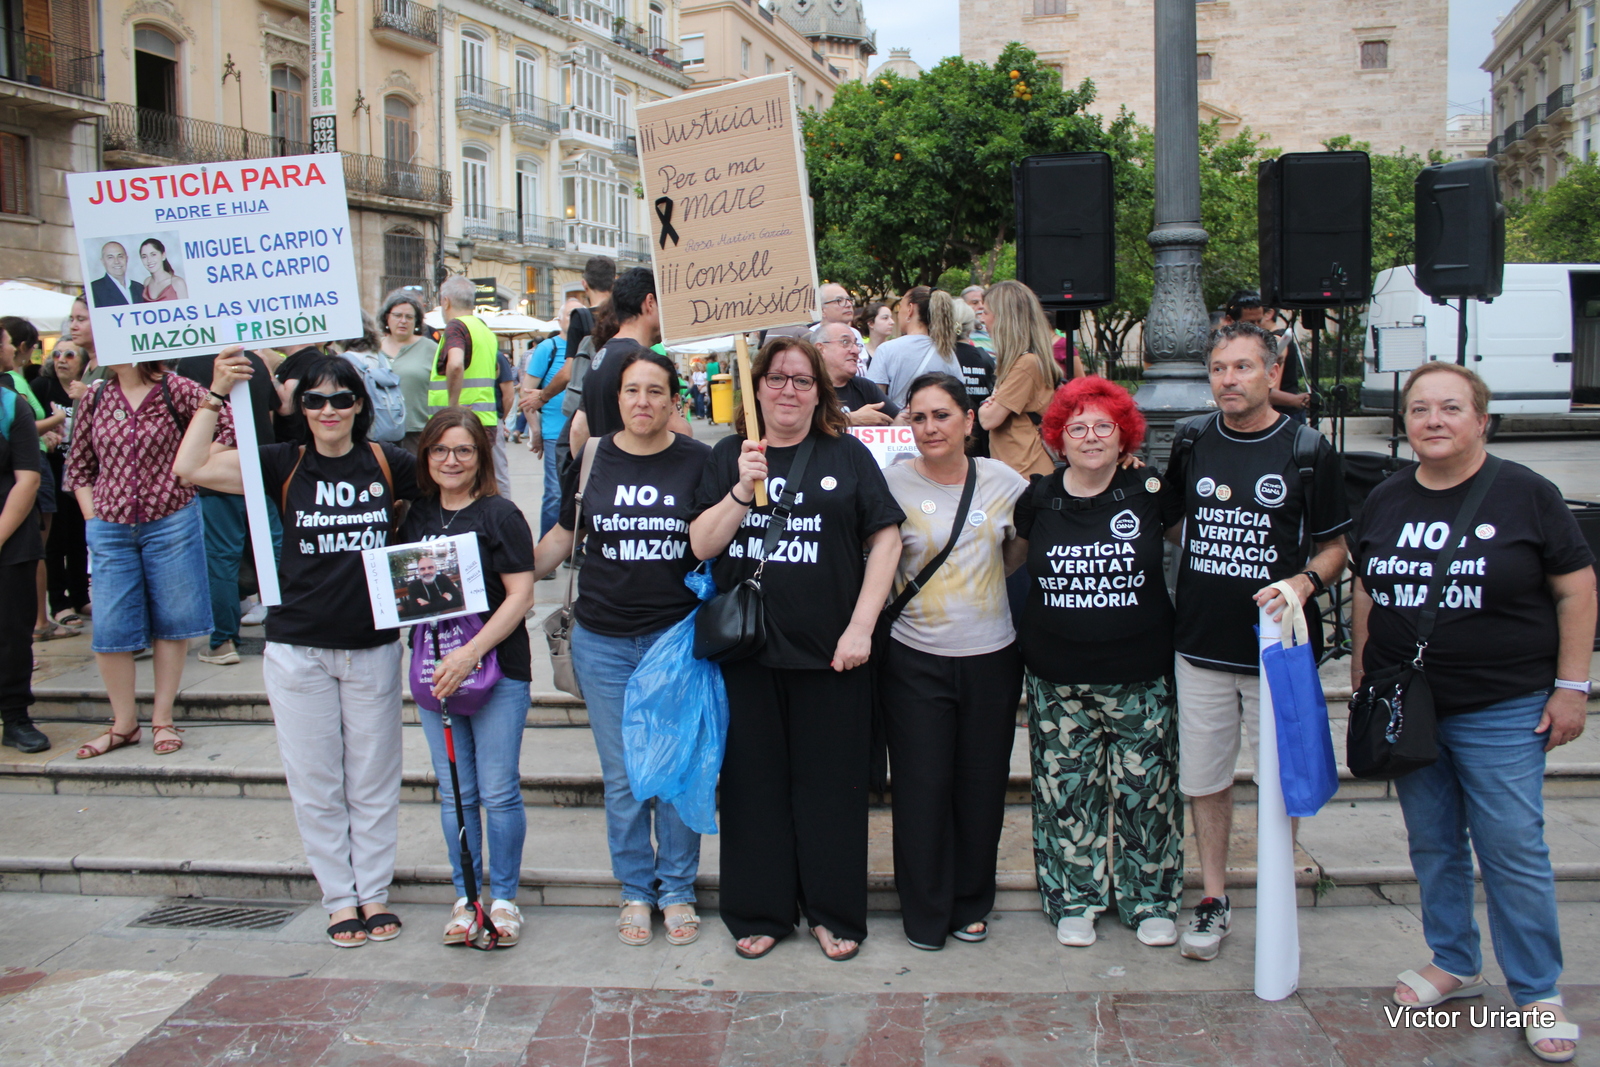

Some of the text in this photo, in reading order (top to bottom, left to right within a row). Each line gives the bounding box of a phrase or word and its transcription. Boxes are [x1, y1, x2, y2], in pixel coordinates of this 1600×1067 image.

[312, 116, 334, 130] 960
[313, 129, 334, 142] 032
[313, 141, 335, 154] 346
[241, 162, 326, 191] PARA
[658, 156, 765, 194] Per a ma
[155, 199, 269, 222] PADRE E HIJA
[680, 184, 765, 222] mare
[184, 227, 344, 260] MIGUEL CARPIO Y
[684, 239, 715, 253] Rosa
[206, 255, 330, 284] SARA CARPIO
[112, 291, 339, 328] Y TODAS LAS VICTIMAS
[130, 312, 328, 352] MAZÓN PRISIÓN
[315, 480, 370, 508] NO a
[613, 484, 675, 506] NO a
[764, 477, 786, 503] O
[1194, 506, 1272, 529] JUSTÍCIA
[299, 526, 388, 555] de MAZÓN
[1198, 523, 1269, 545] VERITAT
[1396, 521, 1450, 550] NO
[601, 535, 688, 561] de MAZÓN
[728, 539, 744, 558] de
[1046, 541, 1136, 558] JUSTÍCIA
[1190, 538, 1279, 563] REPARACIÓ
[1050, 557, 1135, 574] VERITAT
[1190, 556, 1272, 580] I MEMÒRIA
[1367, 555, 1487, 577] l'aforaent
[1038, 569, 1146, 591] REPARACIÓ
[1043, 589, 1139, 608] I MEMÒRIA
[1371, 588, 1390, 607] de
